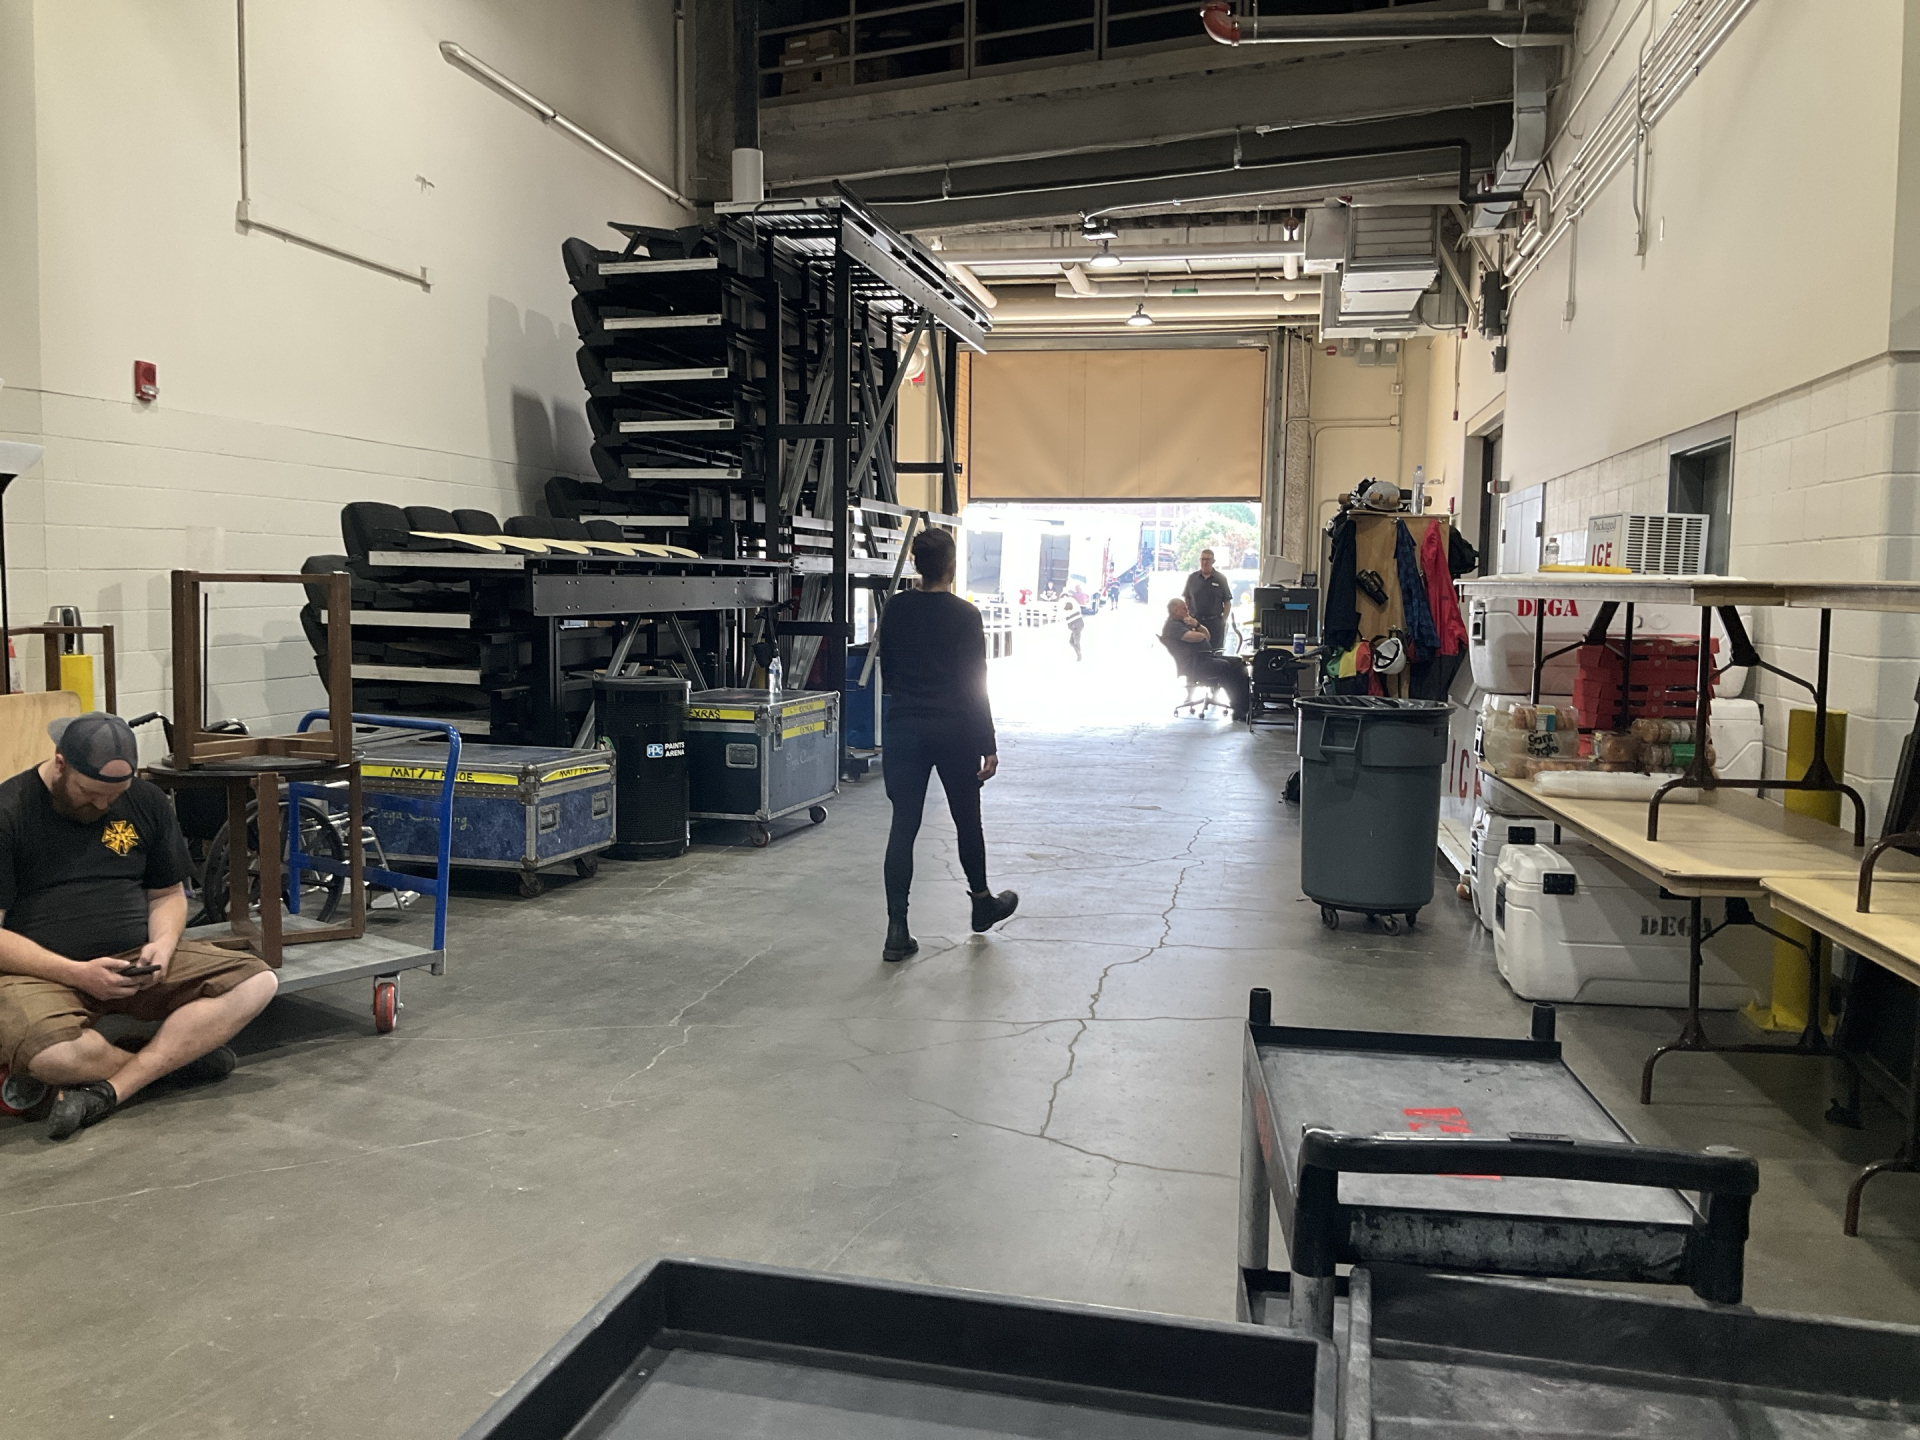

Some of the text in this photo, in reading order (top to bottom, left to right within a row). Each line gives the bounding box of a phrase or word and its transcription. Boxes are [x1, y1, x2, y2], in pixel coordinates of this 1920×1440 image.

[1594, 518, 1617, 533] Packaged
[1591, 541, 1612, 567] ICE
[1517, 598, 1579, 617] DEGA
[648, 745, 663, 757] PPG
[664, 741, 685, 750] PAINTS
[664, 749, 685, 758] ARENA
[390, 767, 475, 783] MAT/TAOE
